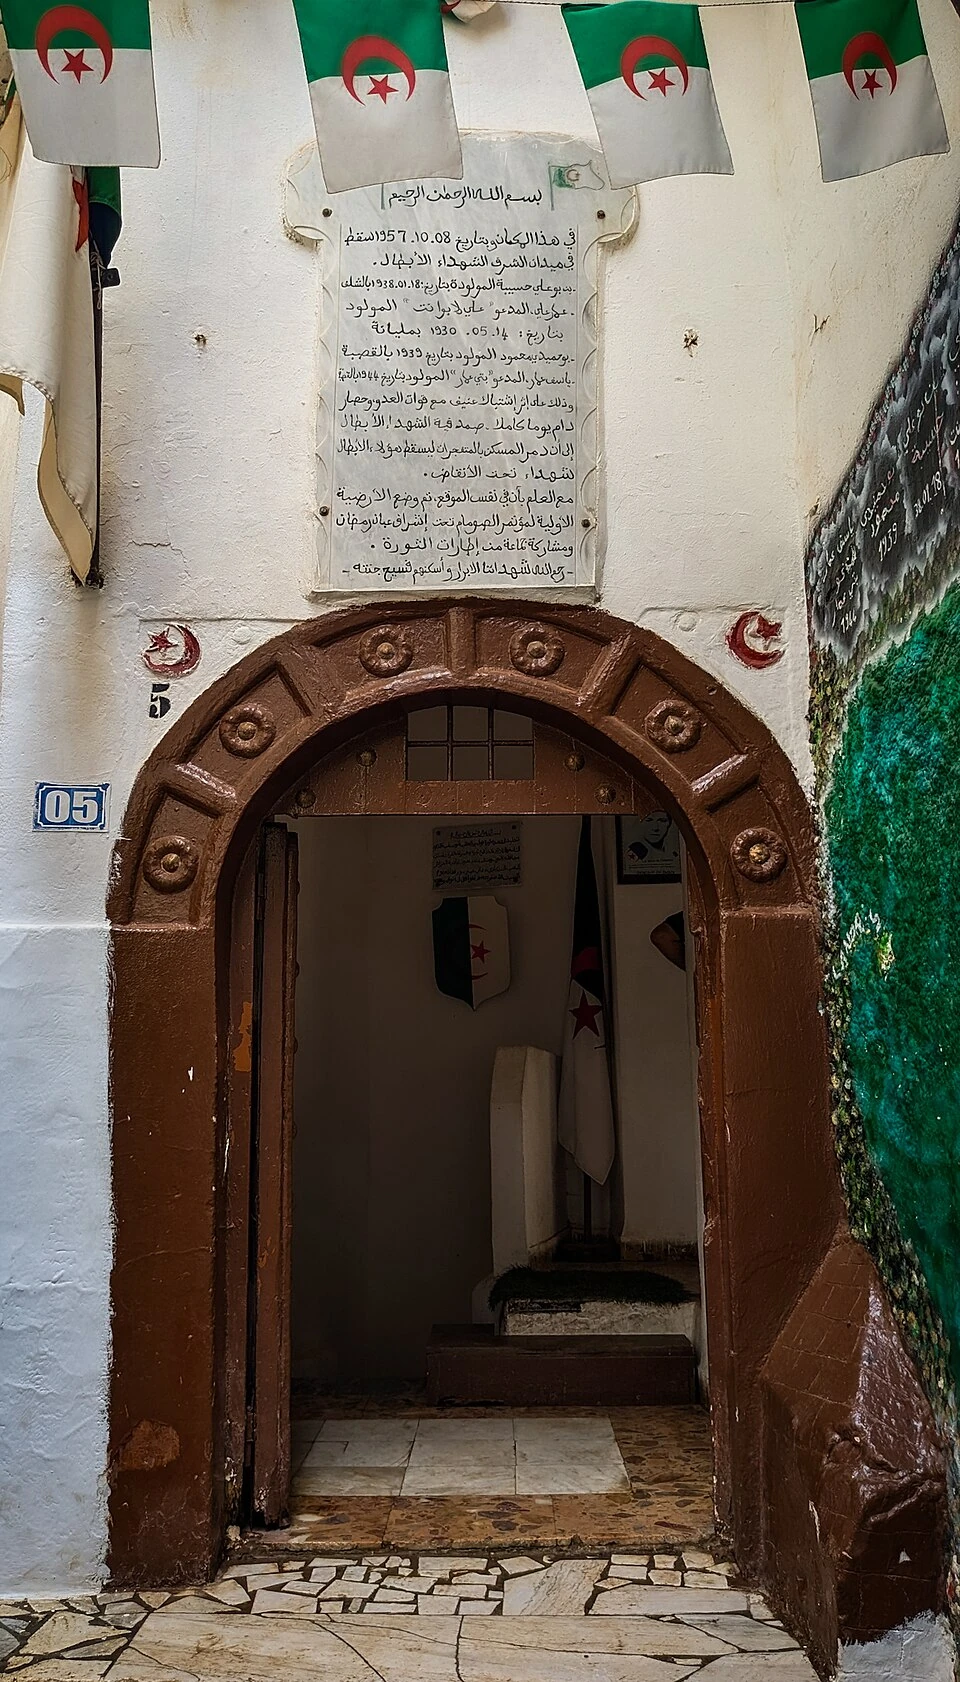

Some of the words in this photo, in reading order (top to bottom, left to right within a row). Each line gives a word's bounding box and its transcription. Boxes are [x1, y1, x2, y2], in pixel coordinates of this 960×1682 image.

[389, 185, 425, 208] الرحيم
[473, 185, 504, 201] الله
[505, 188, 542, 210] بسم
[535, 231, 560, 246] هذا
[563, 228, 576, 250] في
[437, 254, 489, 270] الشهداء
[490, 255, 528, 275] الشرف
[529, 255, 564, 272] ميدان
[564, 252, 575, 271] في
[496, 279, 532, 295] حسيبة
[346, 298, 397, 318] المولود
[493, 302, 530, 320] المدعو
[372, 321, 421, 337] بمليانة
[341, 345, 393, 361] بالقصبة
[396, 348, 422, 358] 1939
[426, 347, 454, 366] بتاريخ
[456, 347, 496, 367] المولود
[406, 369, 450, 386] المولود
[491, 371, 525, 388] المدعو
[405, 392, 428, 410] قوات
[429, 399, 447, 411] مع
[450, 396, 478, 409] عنيف
[547, 397, 573, 413] وذلك
[528, 418, 551, 439] يوما
[551, 418, 574, 441] دام
[403, 440, 435, 457] ليسقط
[484, 442, 524, 456] المسكن
[519, 446, 548, 463] دمر
[561, 442, 574, 461] إلى
[486, 467, 517, 478] تحت
[394, 492, 419, 509] وضع
[499, 489, 509, 507] في
[527, 489, 556, 513] العلم
[556, 495, 573, 508] مع
[336, 512, 372, 533] رمضان
[372, 513, 393, 528] عبان
[432, 518, 455, 526] تحت
[456, 513, 499, 537] الصومام
[495, 514, 536, 535] لمؤتمر
[482, 542, 503, 551] من
[528, 538, 573, 557] ومشاركة
[382, 560, 412, 582] فسيح
[532, 562, 552, 575] الله
[149, 683, 171, 718] 5
[45, 790, 98, 823] 05
